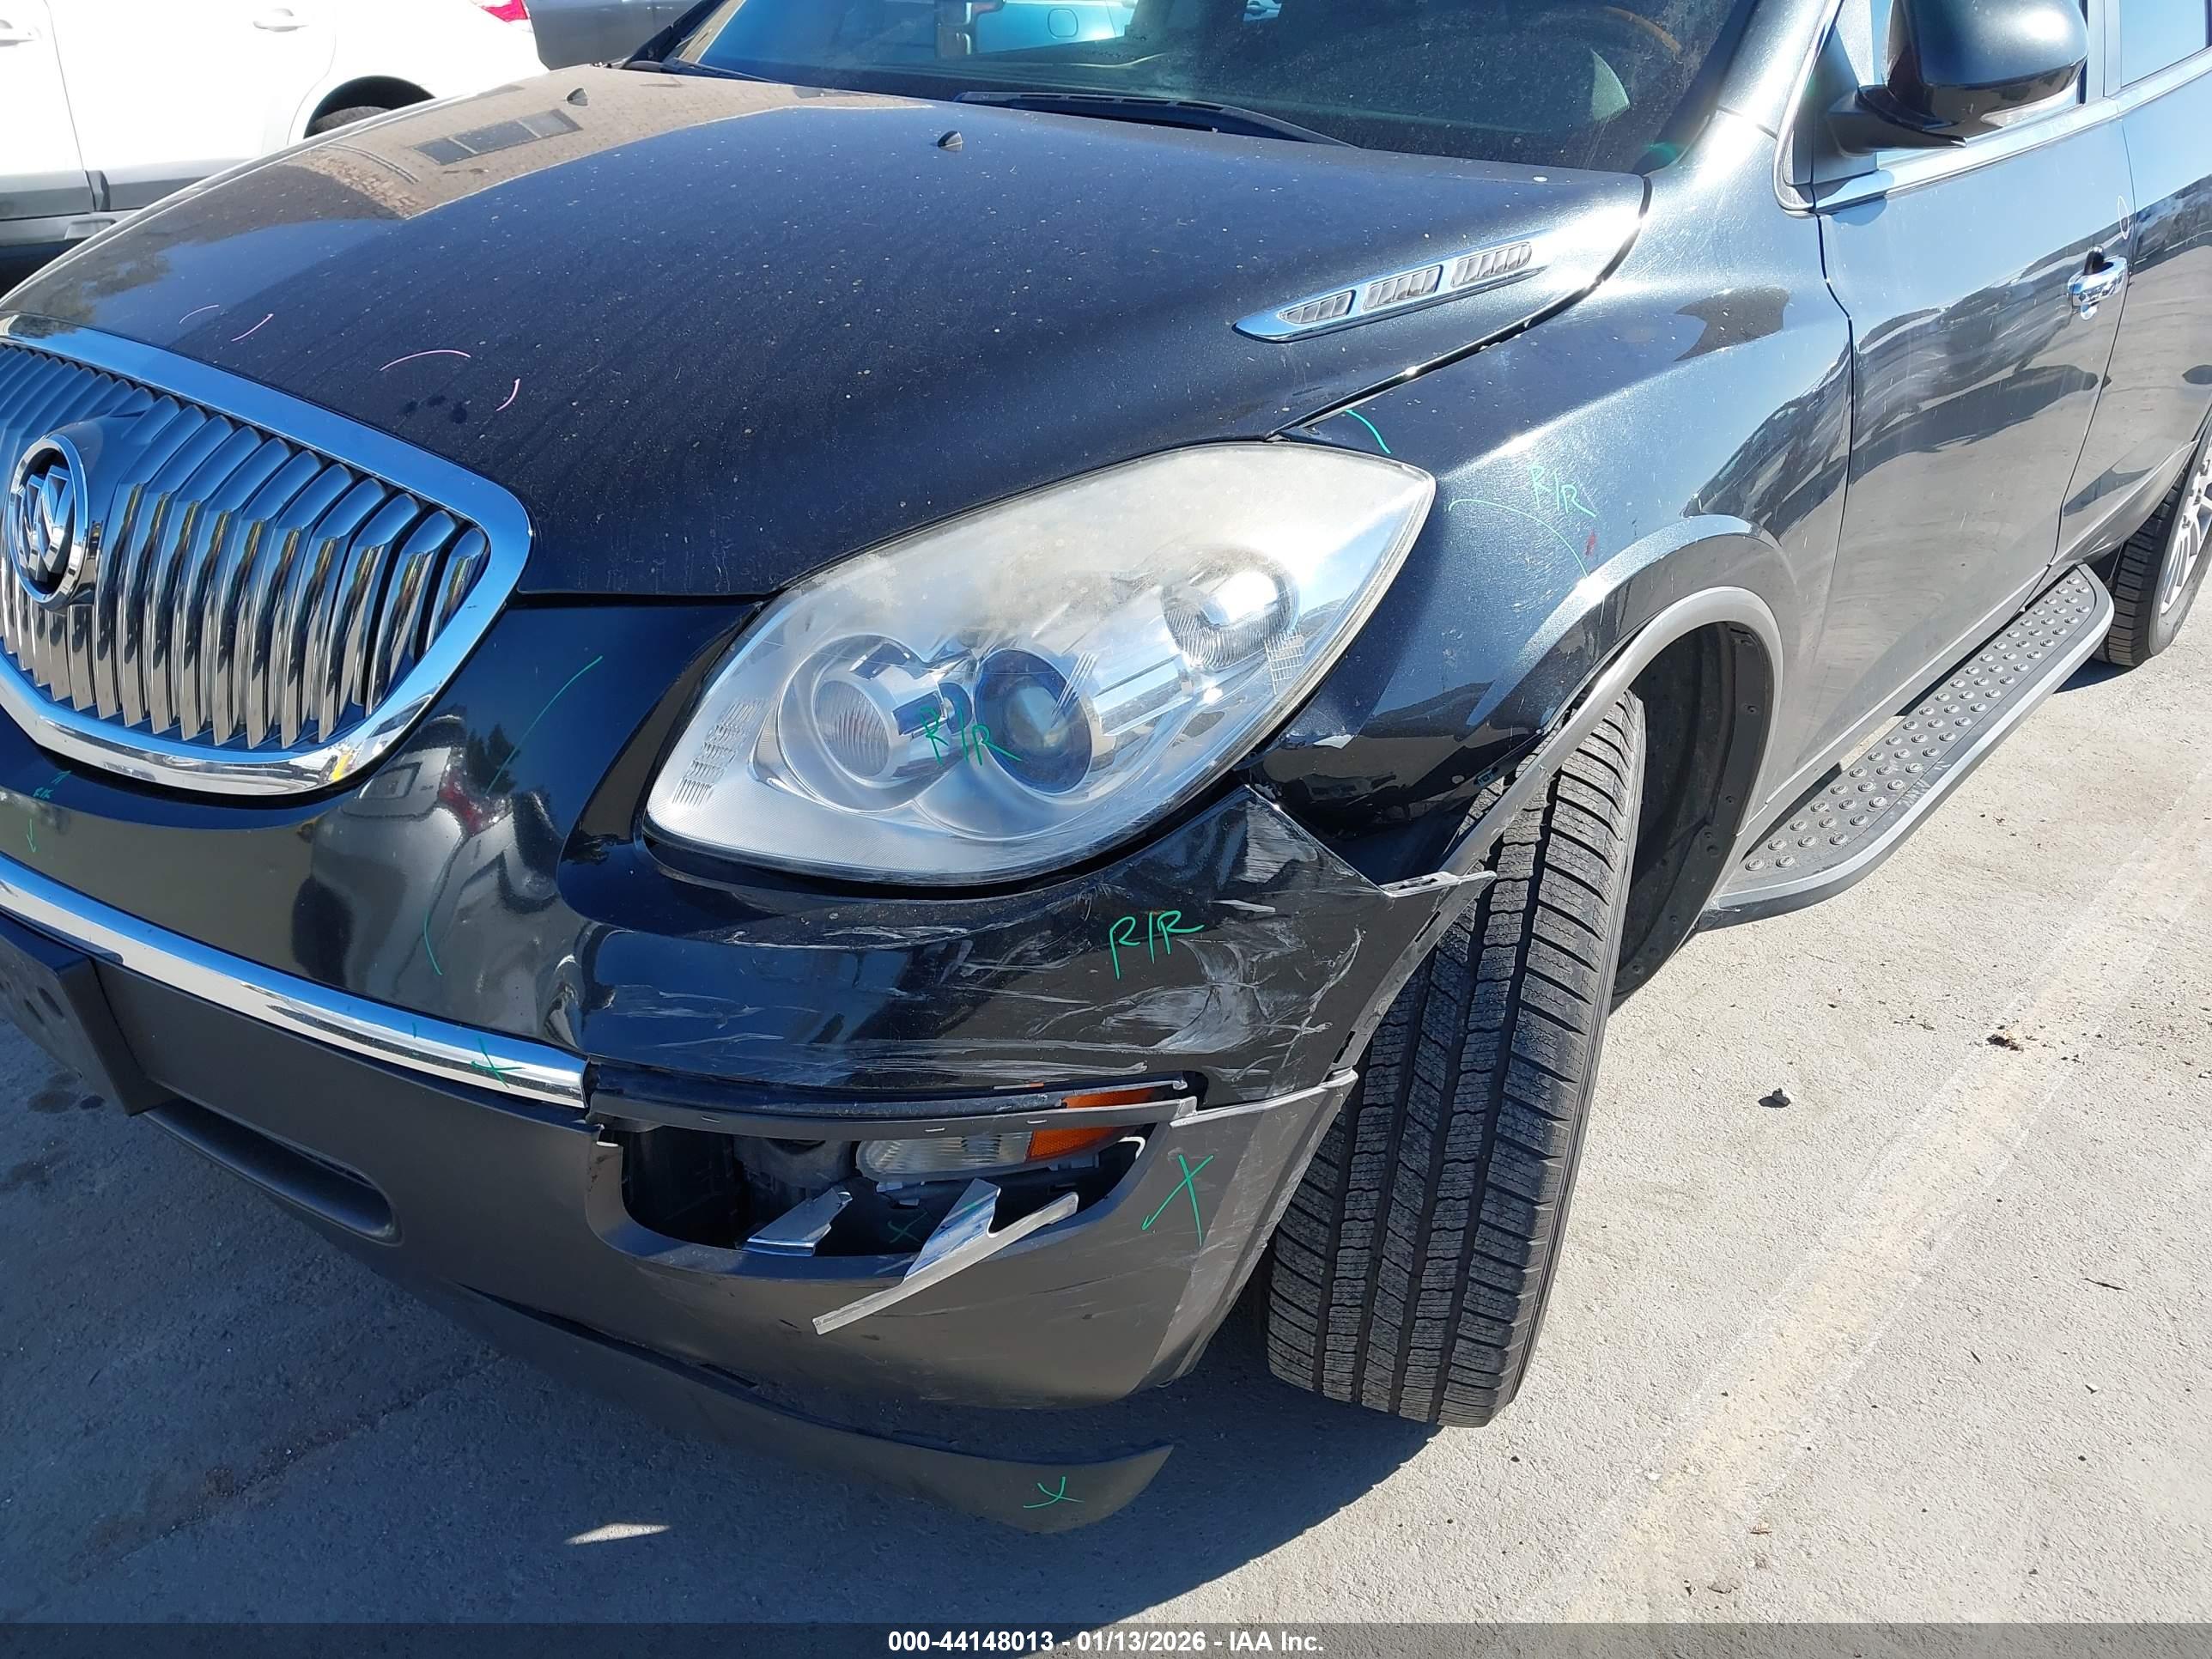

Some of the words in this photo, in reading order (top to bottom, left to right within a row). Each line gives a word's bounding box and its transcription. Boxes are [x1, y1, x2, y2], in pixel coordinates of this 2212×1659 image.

[1528, 465, 1598, 518] R/R
[919, 705, 1024, 769] R/R
[1109, 909, 1206, 981] R/R
